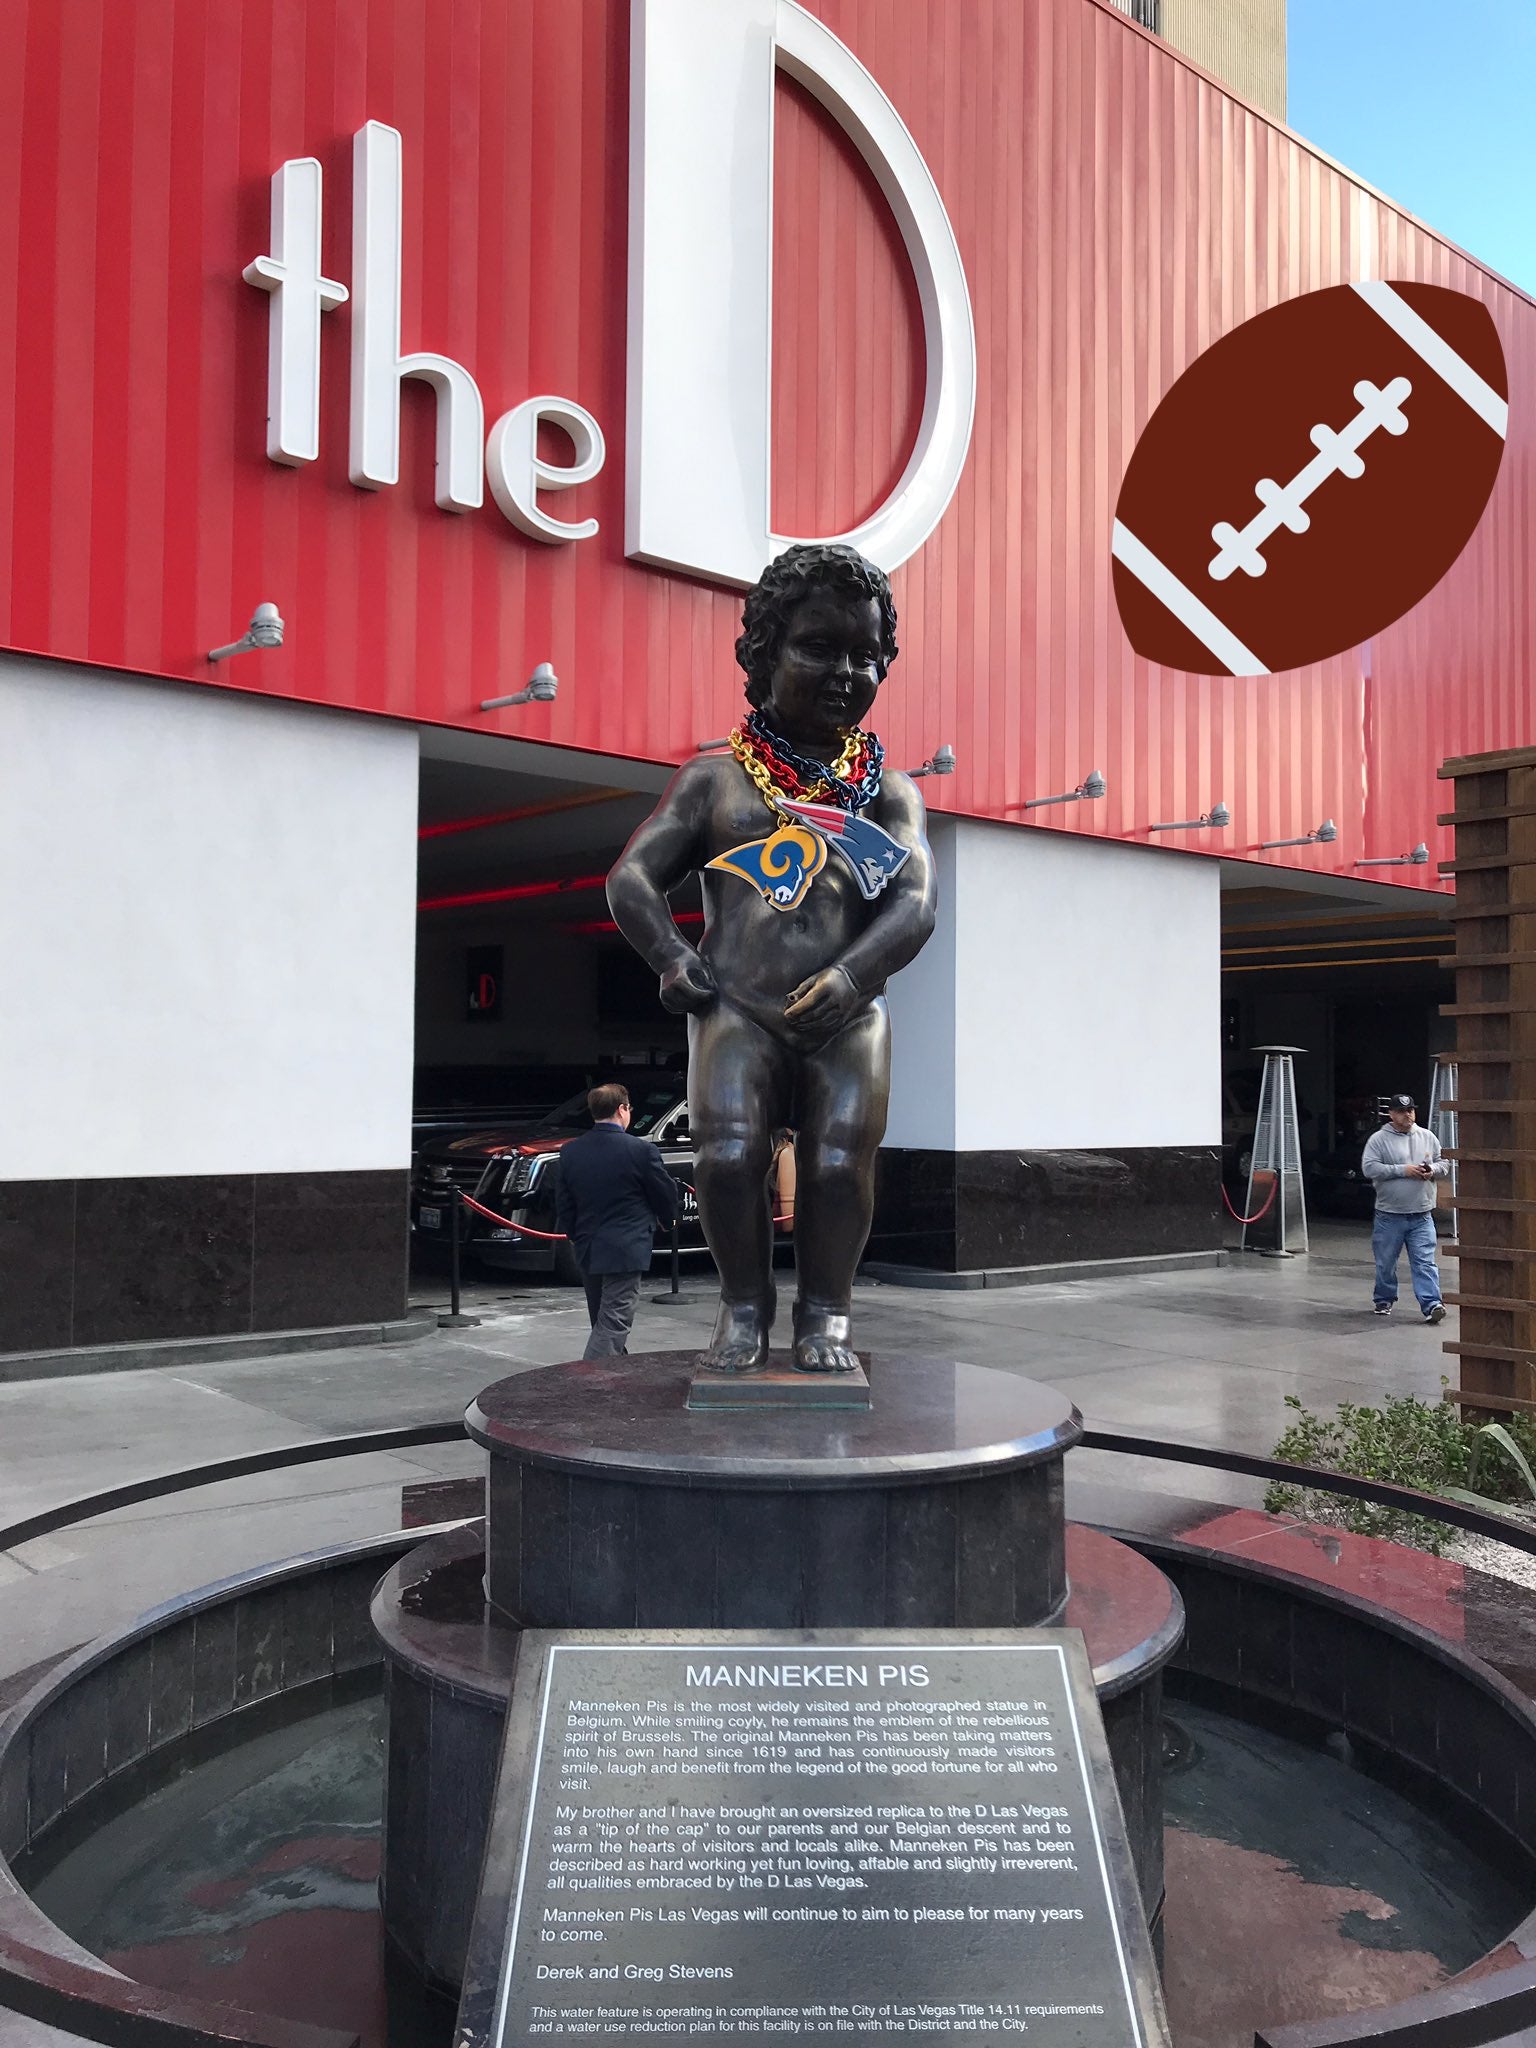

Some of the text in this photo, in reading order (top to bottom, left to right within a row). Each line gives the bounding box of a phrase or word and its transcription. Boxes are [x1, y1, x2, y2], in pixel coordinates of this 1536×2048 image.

[242, 0, 977, 590] the D
[683, 1192, 698, 1210] th
[686, 1664, 930, 1687] MANNEKEN PIS
[568, 1700, 1029, 1715] Manneken Pis the most widely visited and photographed statue
[567, 1714, 1050, 1730] Belgium. While smiling coyly, remains the emblem the rebellious
[564, 1730, 1053, 1745] spirit Brussels. The original Manneken Pis has been taking matters
[563, 1745, 1056, 1760] into his own hand since 1619 and has continuously made visitors
[561, 1760, 1058, 1777] smile, laugh and benefit from the legend the good fortune for all who
[559, 1777, 591, 1790] visit.
[556, 1804, 1069, 1822] My brother and have brought oversized replica the D Las Vegas
[595, 1821, 1051, 1839] "tip the cap" our parents and our Belgian descent and
[551, 1838, 1075, 1854] warm the hearts visitors and locals alike. Manneken Pis has been
[549, 1856, 1078, 1874] described hard working yet fun loving, affable and slightly irreverent,
[547, 1874, 869, 1892] all qualities embraced the D Las Vegas.
[543, 1906, 1084, 1925] Manneken Pis Las Vegas will continue aim please for many years
[560, 1930, 608, 1942] come.
[536, 1964, 734, 1982] Derek and Greg Stevens
[531, 2003, 1105, 2020] This water feature operating compliance with the City Las Vegas Title 14.11 requirements
[528, 2018, 1029, 2034] and water use reduction plan facility file with District and City.
